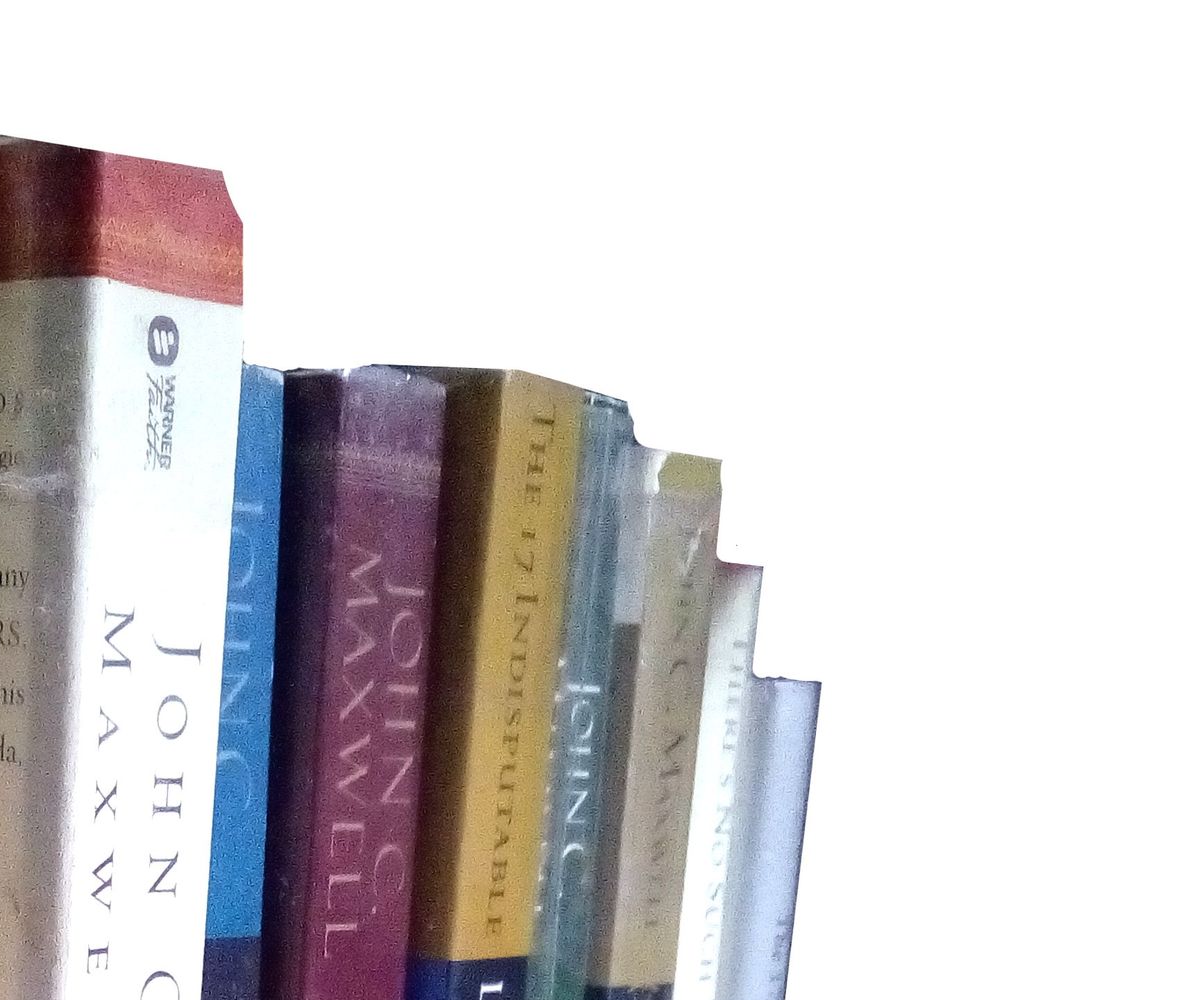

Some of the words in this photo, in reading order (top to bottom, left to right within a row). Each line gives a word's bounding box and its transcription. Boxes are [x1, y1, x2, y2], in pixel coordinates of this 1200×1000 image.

[160, 375, 176, 470] WARNER
[522, 400, 556, 510] THE
[513, 529, 535, 569] 17
[149, 634, 202, 898] JOHN
[323, 543, 382, 958] MAXWELL
[380, 580, 426, 805] JOHN
[487, 594, 541, 937] INDISPUTABLE
[564, 682, 601, 823] JOHN
